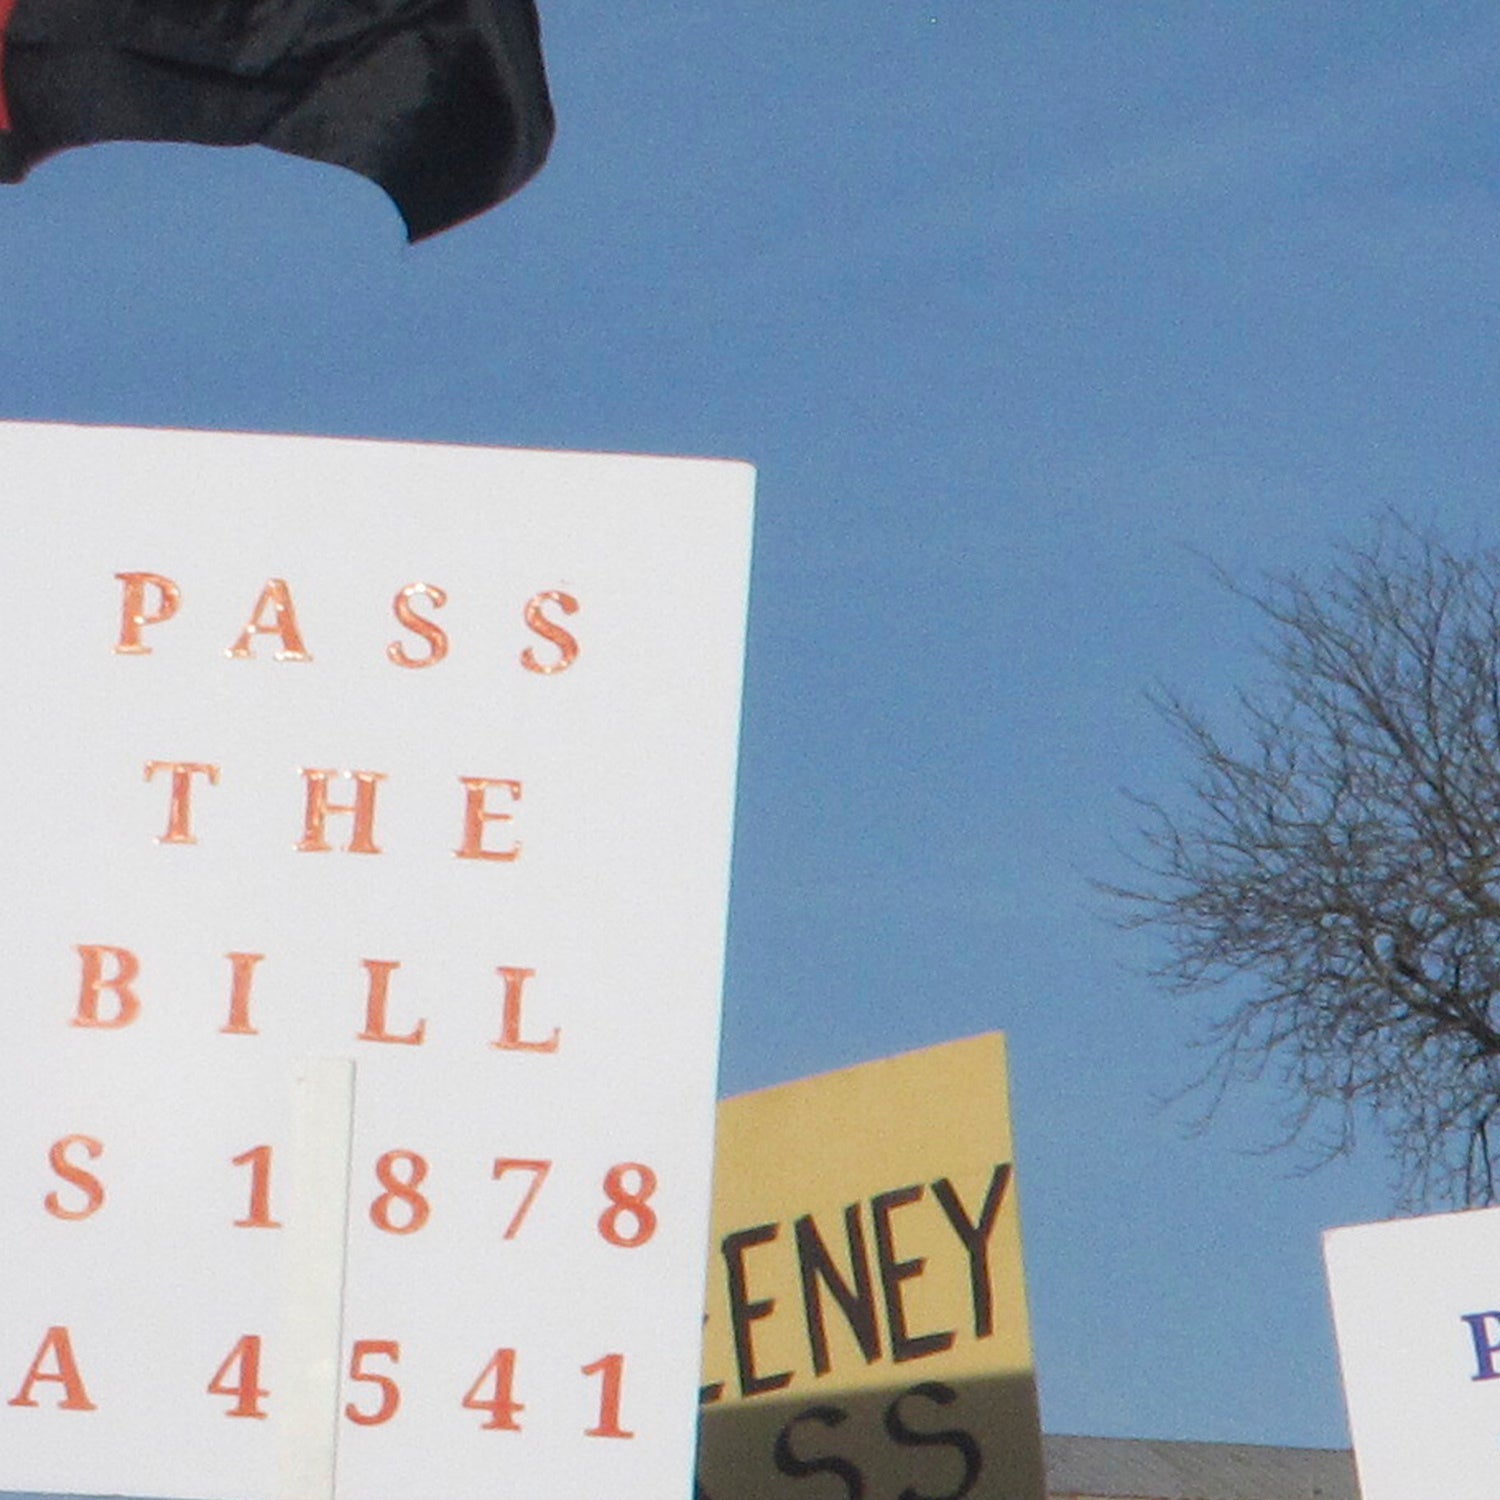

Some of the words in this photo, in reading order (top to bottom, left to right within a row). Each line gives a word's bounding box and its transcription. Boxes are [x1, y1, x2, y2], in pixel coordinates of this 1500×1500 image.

[111, 571, 583, 675] PASS
[144, 760, 525, 862] THE
[68, 944, 562, 1054] BILL
[700, 1163, 1014, 1405] ENEY
